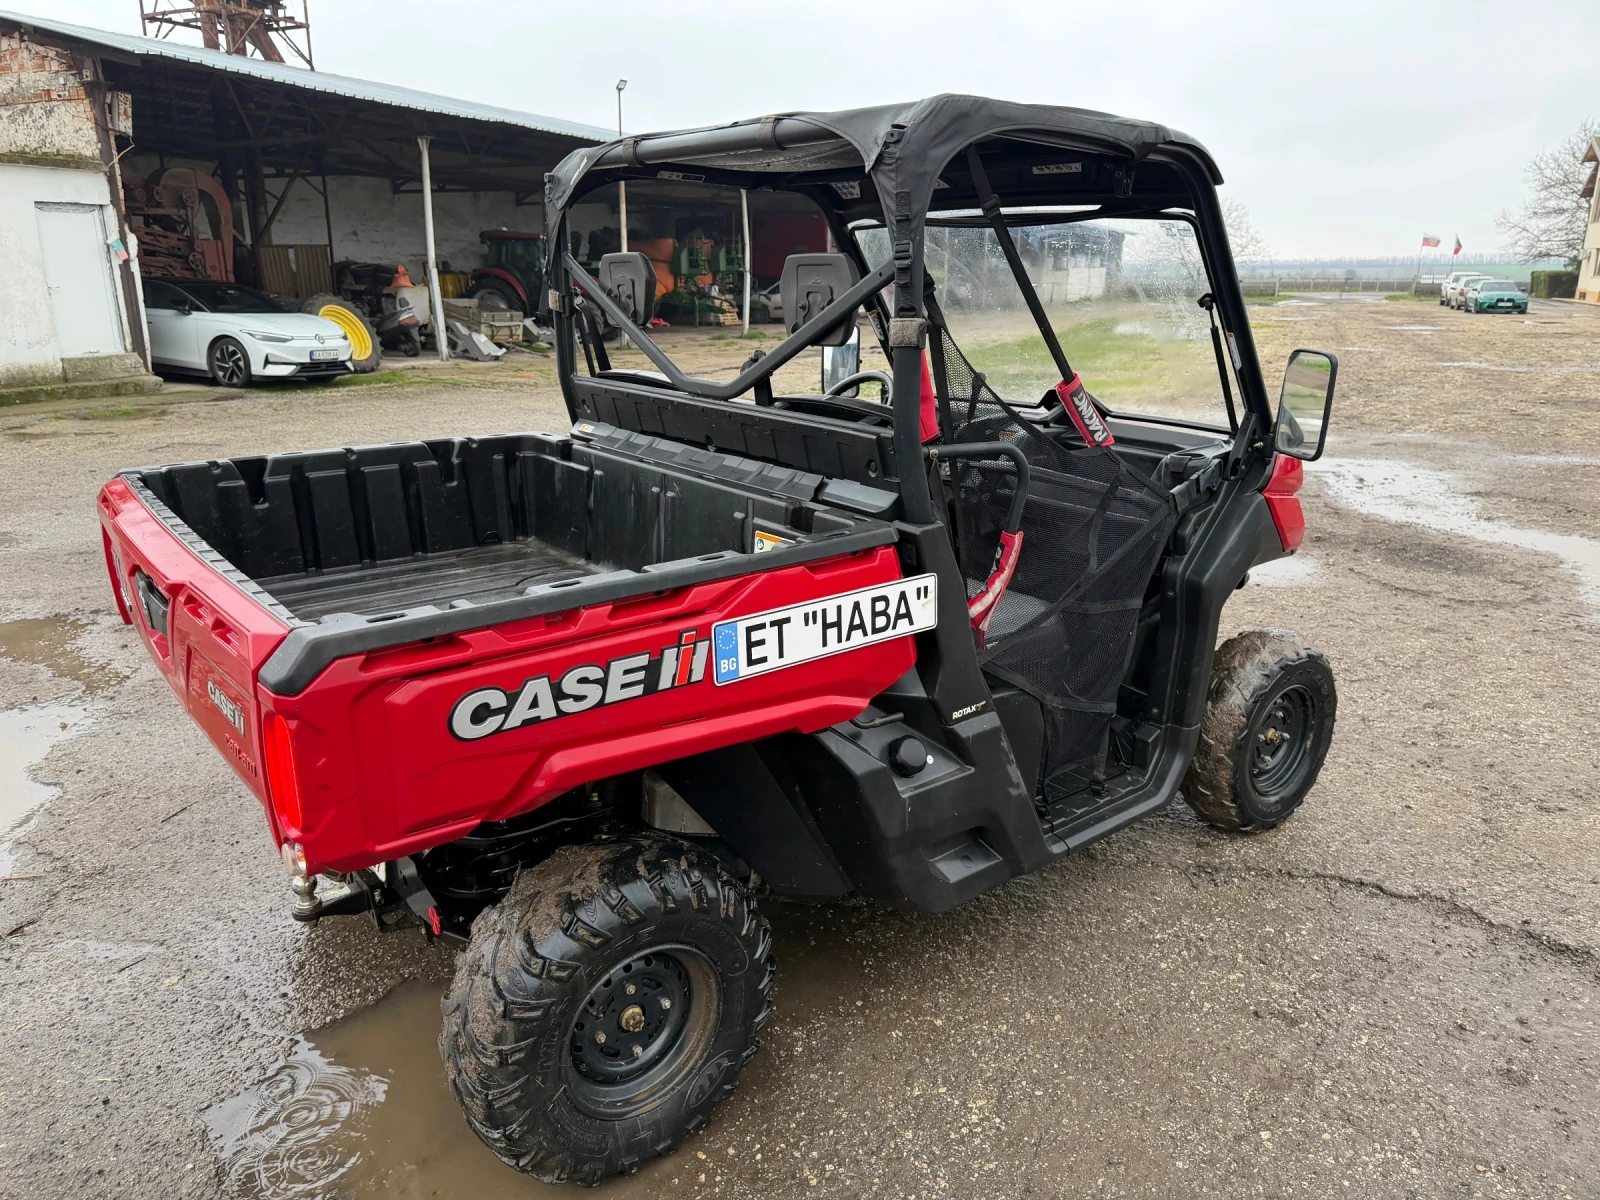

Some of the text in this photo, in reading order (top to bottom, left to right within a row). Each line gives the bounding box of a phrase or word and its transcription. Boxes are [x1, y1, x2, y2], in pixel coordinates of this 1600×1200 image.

[1073, 389, 1108, 442] RACING
[745, 585, 929, 667] ET "HABA"
[720, 657, 737, 673] BG
[207, 679, 235, 726] CASE
[451, 653, 650, 740] CASE
[952, 704, 977, 720] ROTAX
